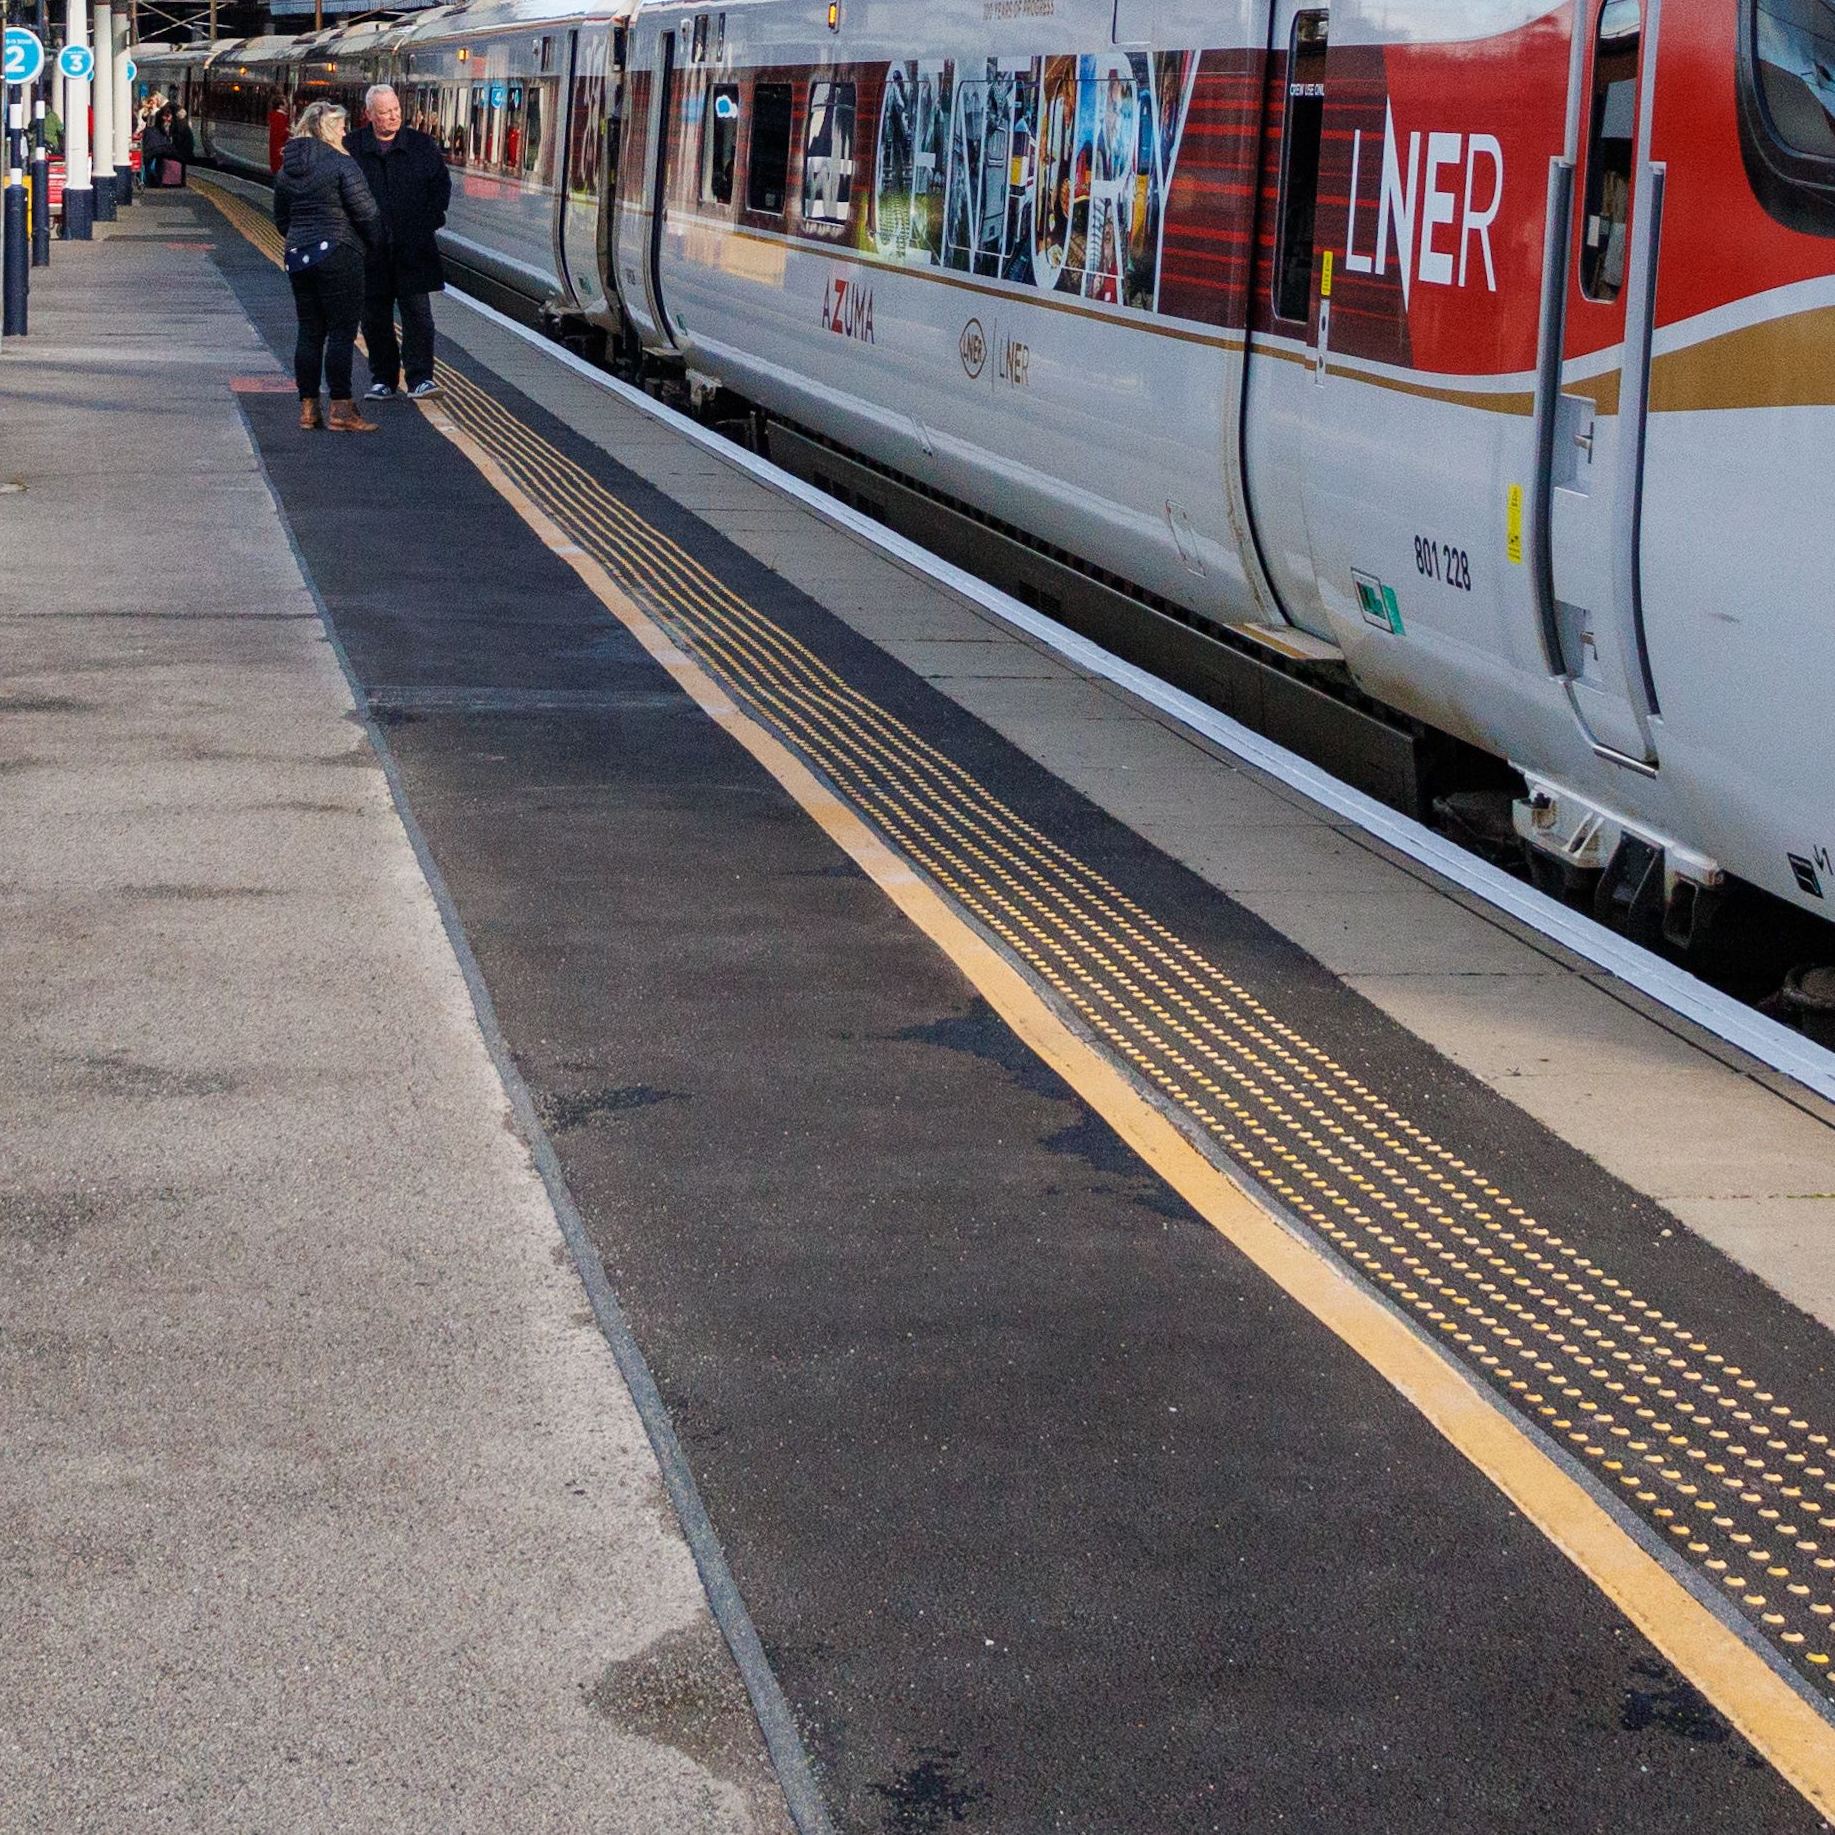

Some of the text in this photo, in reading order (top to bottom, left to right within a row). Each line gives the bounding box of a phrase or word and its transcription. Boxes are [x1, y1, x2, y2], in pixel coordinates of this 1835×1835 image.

[5, 46, 25, 72] 2
[69, 54, 83, 71] 3
[874, 49, 1201, 313] CENTURY
[1345, 94, 1503, 312] LNER
[821, 275, 875, 344] AZUMA
[964, 332, 982, 364] LNER
[999, 332, 1030, 387] LNER
[1414, 535, 1471, 591] 801 228
